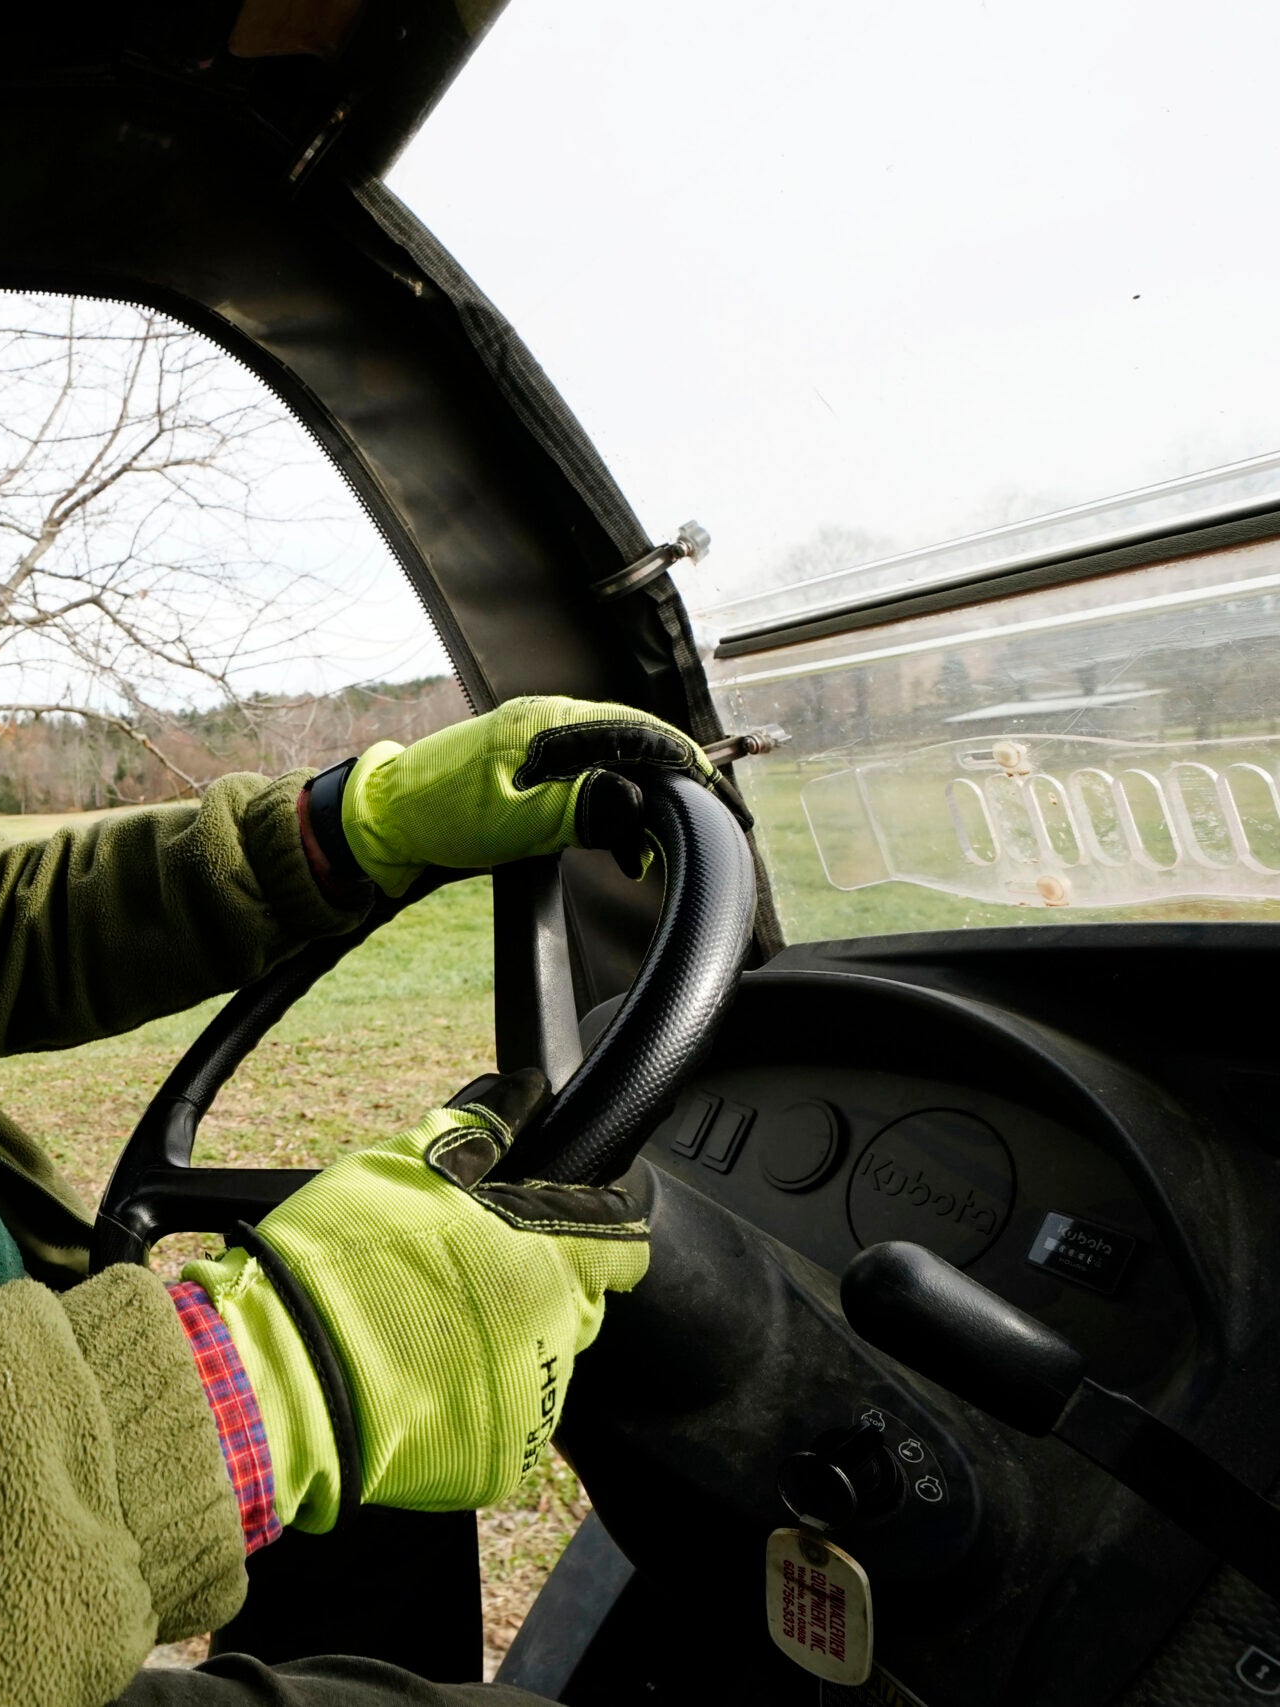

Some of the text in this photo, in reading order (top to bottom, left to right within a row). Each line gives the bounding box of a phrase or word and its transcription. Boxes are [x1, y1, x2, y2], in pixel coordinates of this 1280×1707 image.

[861, 1152, 997, 1235] Kubota
[1057, 1224, 1112, 1255] Kubota
[783, 1559, 795, 1638] 603-756-3379
[797, 1602, 806, 1618] NH
[808, 1569, 827, 1631] EQUIPMENT,
[829, 1583, 846, 1663] PINNACLEVIEW
